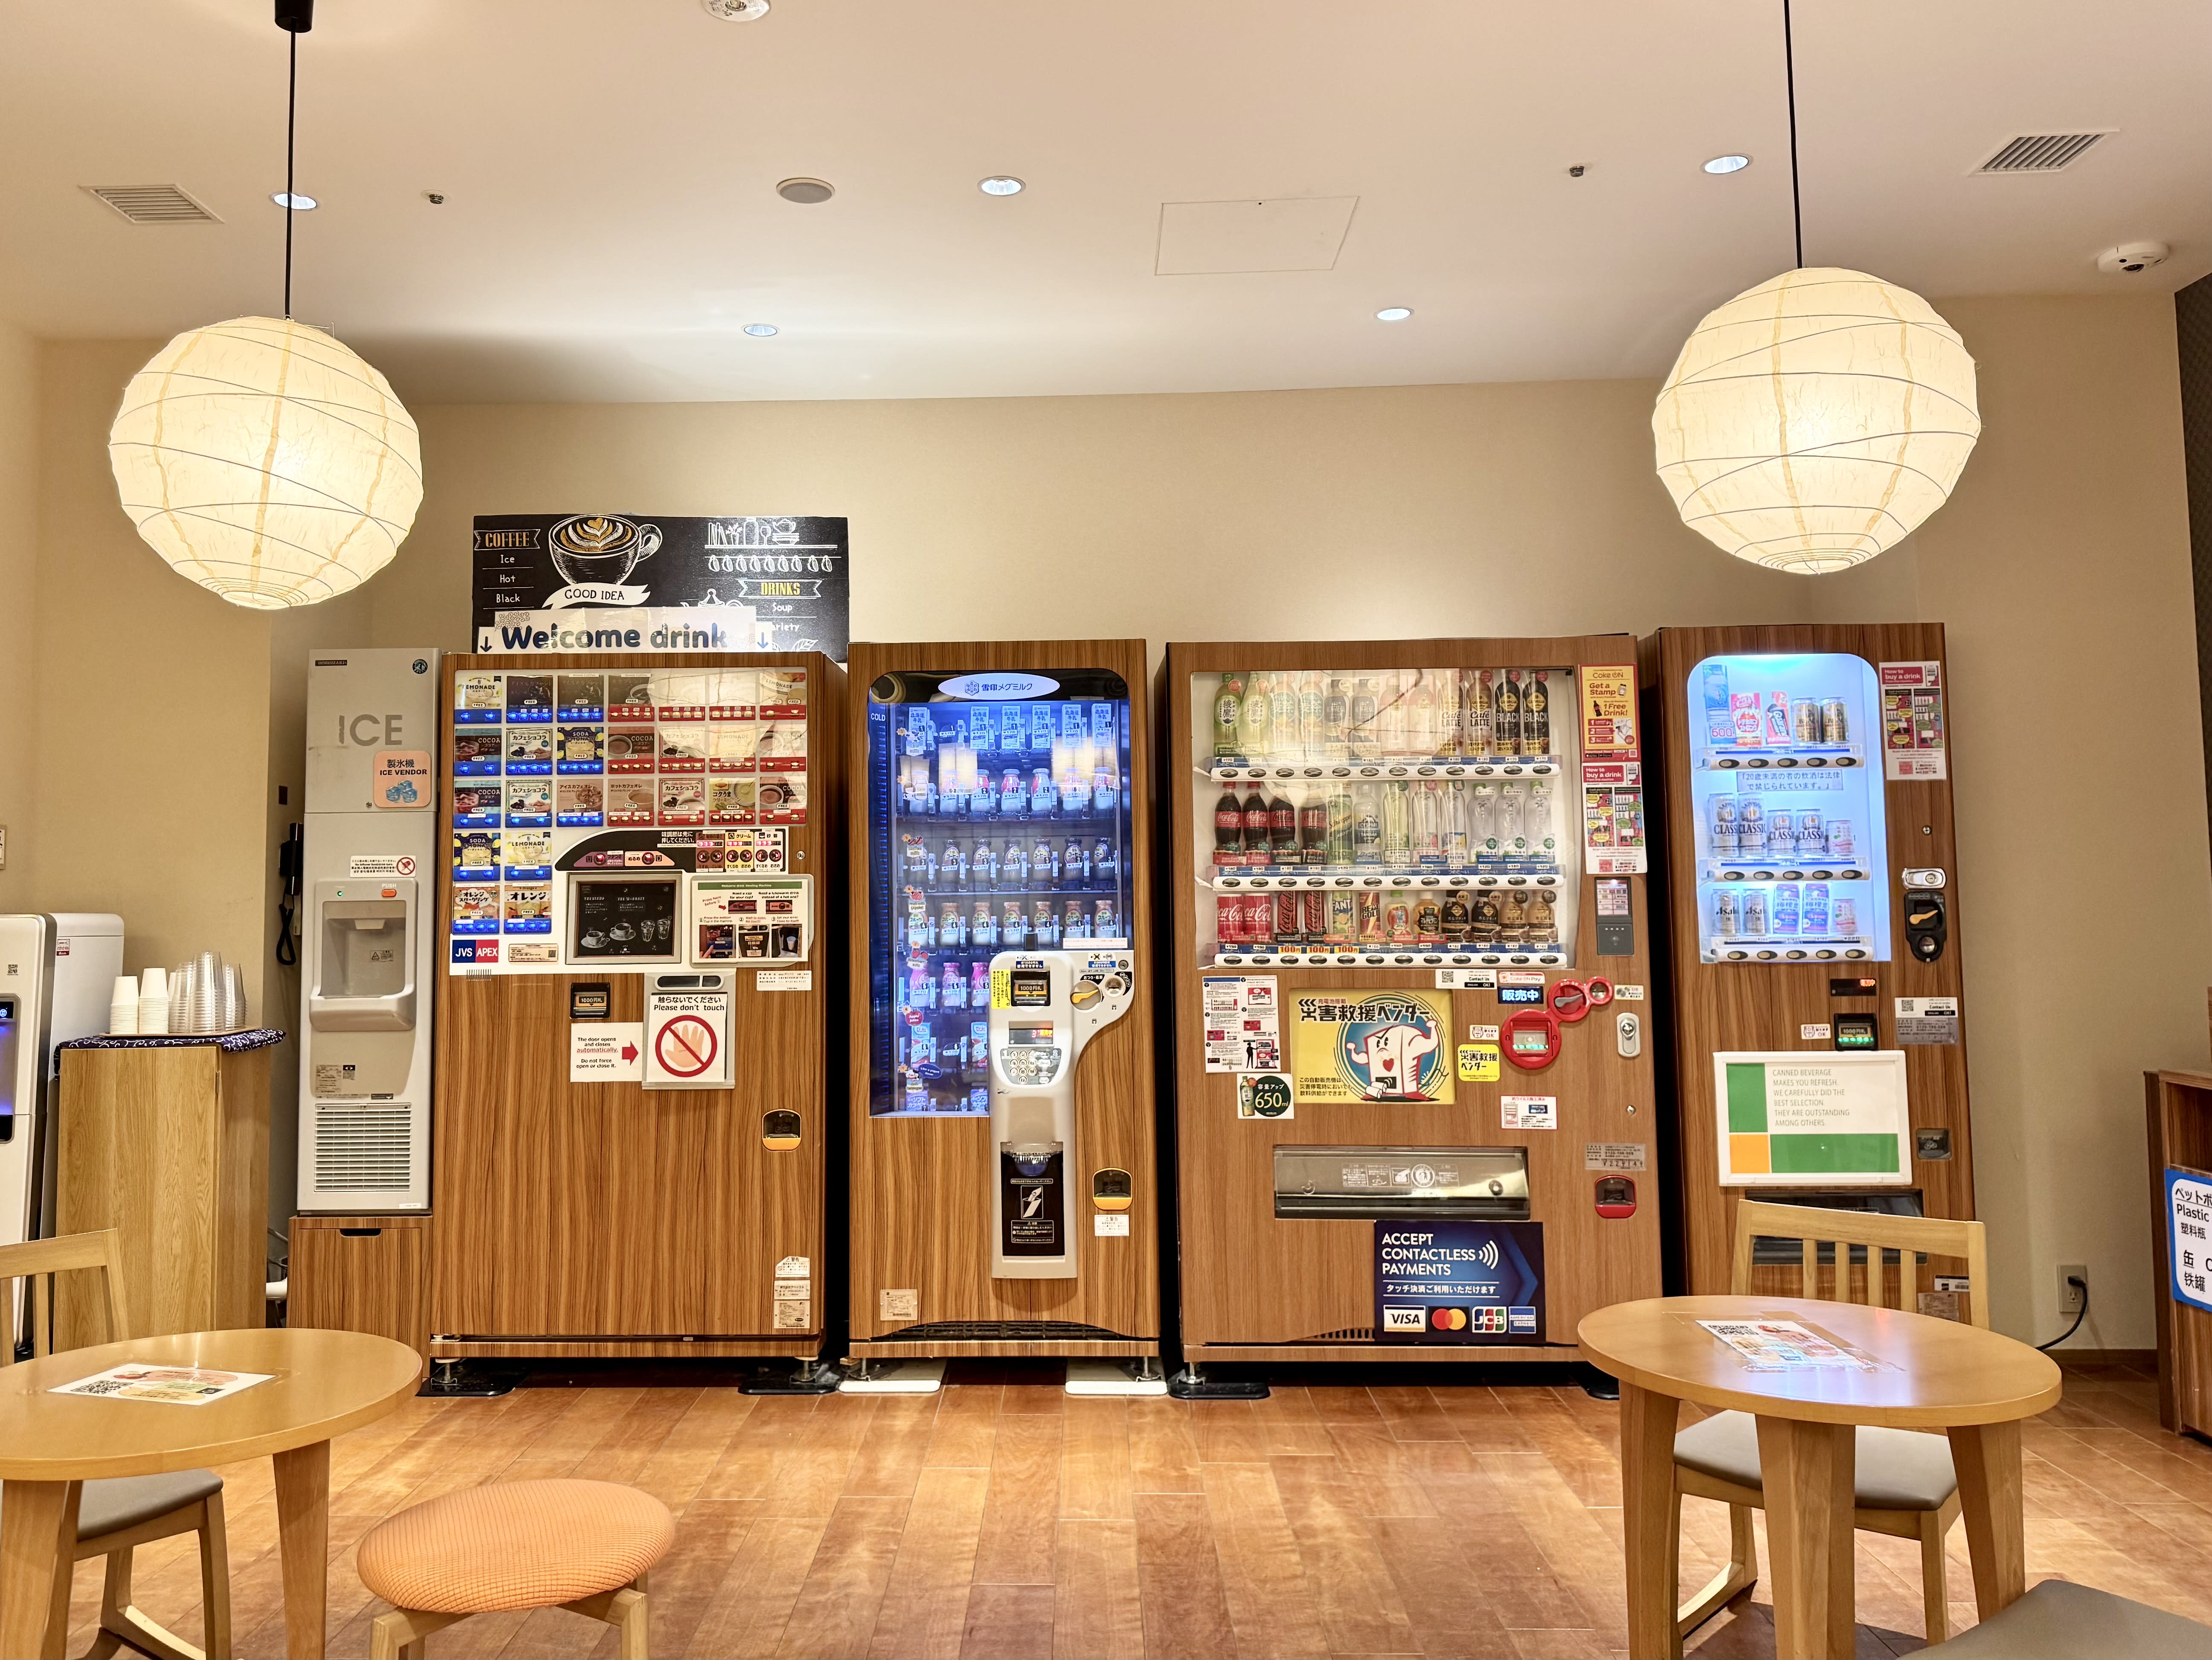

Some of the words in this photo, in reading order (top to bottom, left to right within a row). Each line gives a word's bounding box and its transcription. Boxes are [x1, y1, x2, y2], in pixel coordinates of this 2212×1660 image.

[485, 531, 529, 547] COFFEE
[501, 555, 515, 563] Ice
[500, 574, 515, 583] Hot
[761, 582, 800, 595] DRINKS
[496, 594, 520, 603] Black
[565, 589, 597, 600] GOOD
[601, 590, 624, 600] IDEA
[772, 603, 792, 613] Soup
[502, 624, 640, 649] Welcome
[651, 624, 727, 648] drink
[981, 683, 1033, 691] 雪印メグミルク
[1222, 699, 1232, 718] 綾鷹
[1496, 713, 1520, 722] BLACK
[1525, 712, 1548, 722] BLACK
[339, 714, 402, 746] ICE
[1712, 727, 1733, 737] 600
[387, 759, 415, 768] 製氷機
[1218, 814, 1239, 822] Coca-Cola
[1246, 814, 1267, 822] Coca-Cola
[510, 892, 546, 901] オレンジ
[1362, 905, 1379, 913] REAL
[1362, 911, 1379, 919] GOLD
[456, 948, 472, 957] JVS
[476, 947, 497, 956] APEX
[1502, 989, 1539, 1001] 販売中
[1298, 999, 1430, 1022] 災害救援ベンダー
[1460, 1050, 1498, 1061] 災害救援
[1461, 1062, 1486, 1071] ベンダー
[1255, 1092, 1282, 1109] 650
[2177, 1203, 2209, 1222] Plastic
[2181, 1222, 2206, 1240] 塑料瓶
[1382, 1233, 1434, 1245] ACCEPT
[1382, 1249, 1475, 1260] CONTACTLESS
[2183, 1249, 2194, 1266] 缶
[1382, 1263, 1451, 1275] PAYMENTS
[1386, 1284, 1495, 1294] タッチ決済ご利用いただけます
[1390, 1313, 1420, 1324] VISA
[1474, 1315, 1504, 1324] JCB
